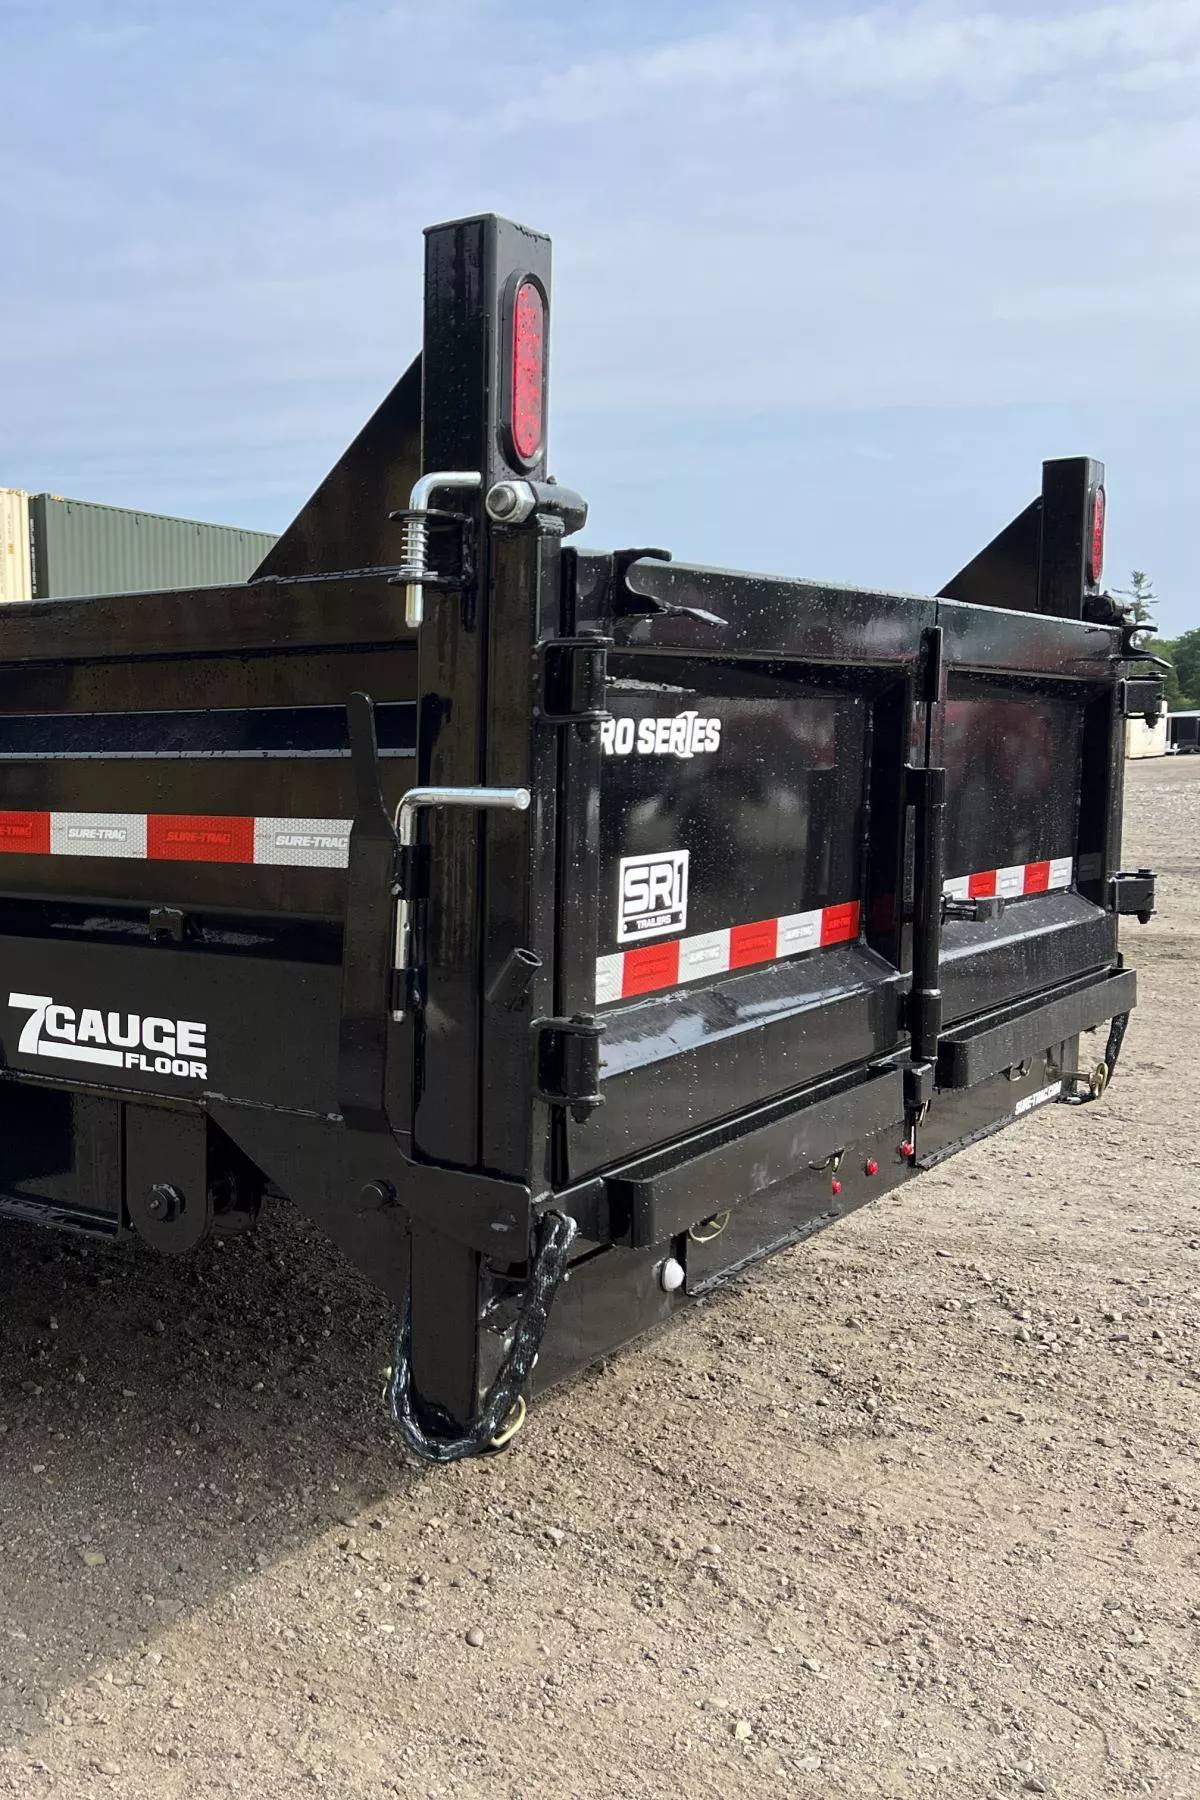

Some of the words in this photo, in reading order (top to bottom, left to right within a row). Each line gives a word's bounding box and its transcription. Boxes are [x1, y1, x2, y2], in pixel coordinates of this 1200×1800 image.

[637, 710, 722, 758] SERIES
[68, 828, 127, 842] SURE-TRAC
[275, 834, 349, 849] SURE-TRAC
[636, 914, 672, 930] TRAILERS
[125, 1052, 208, 1080] FLOOR
